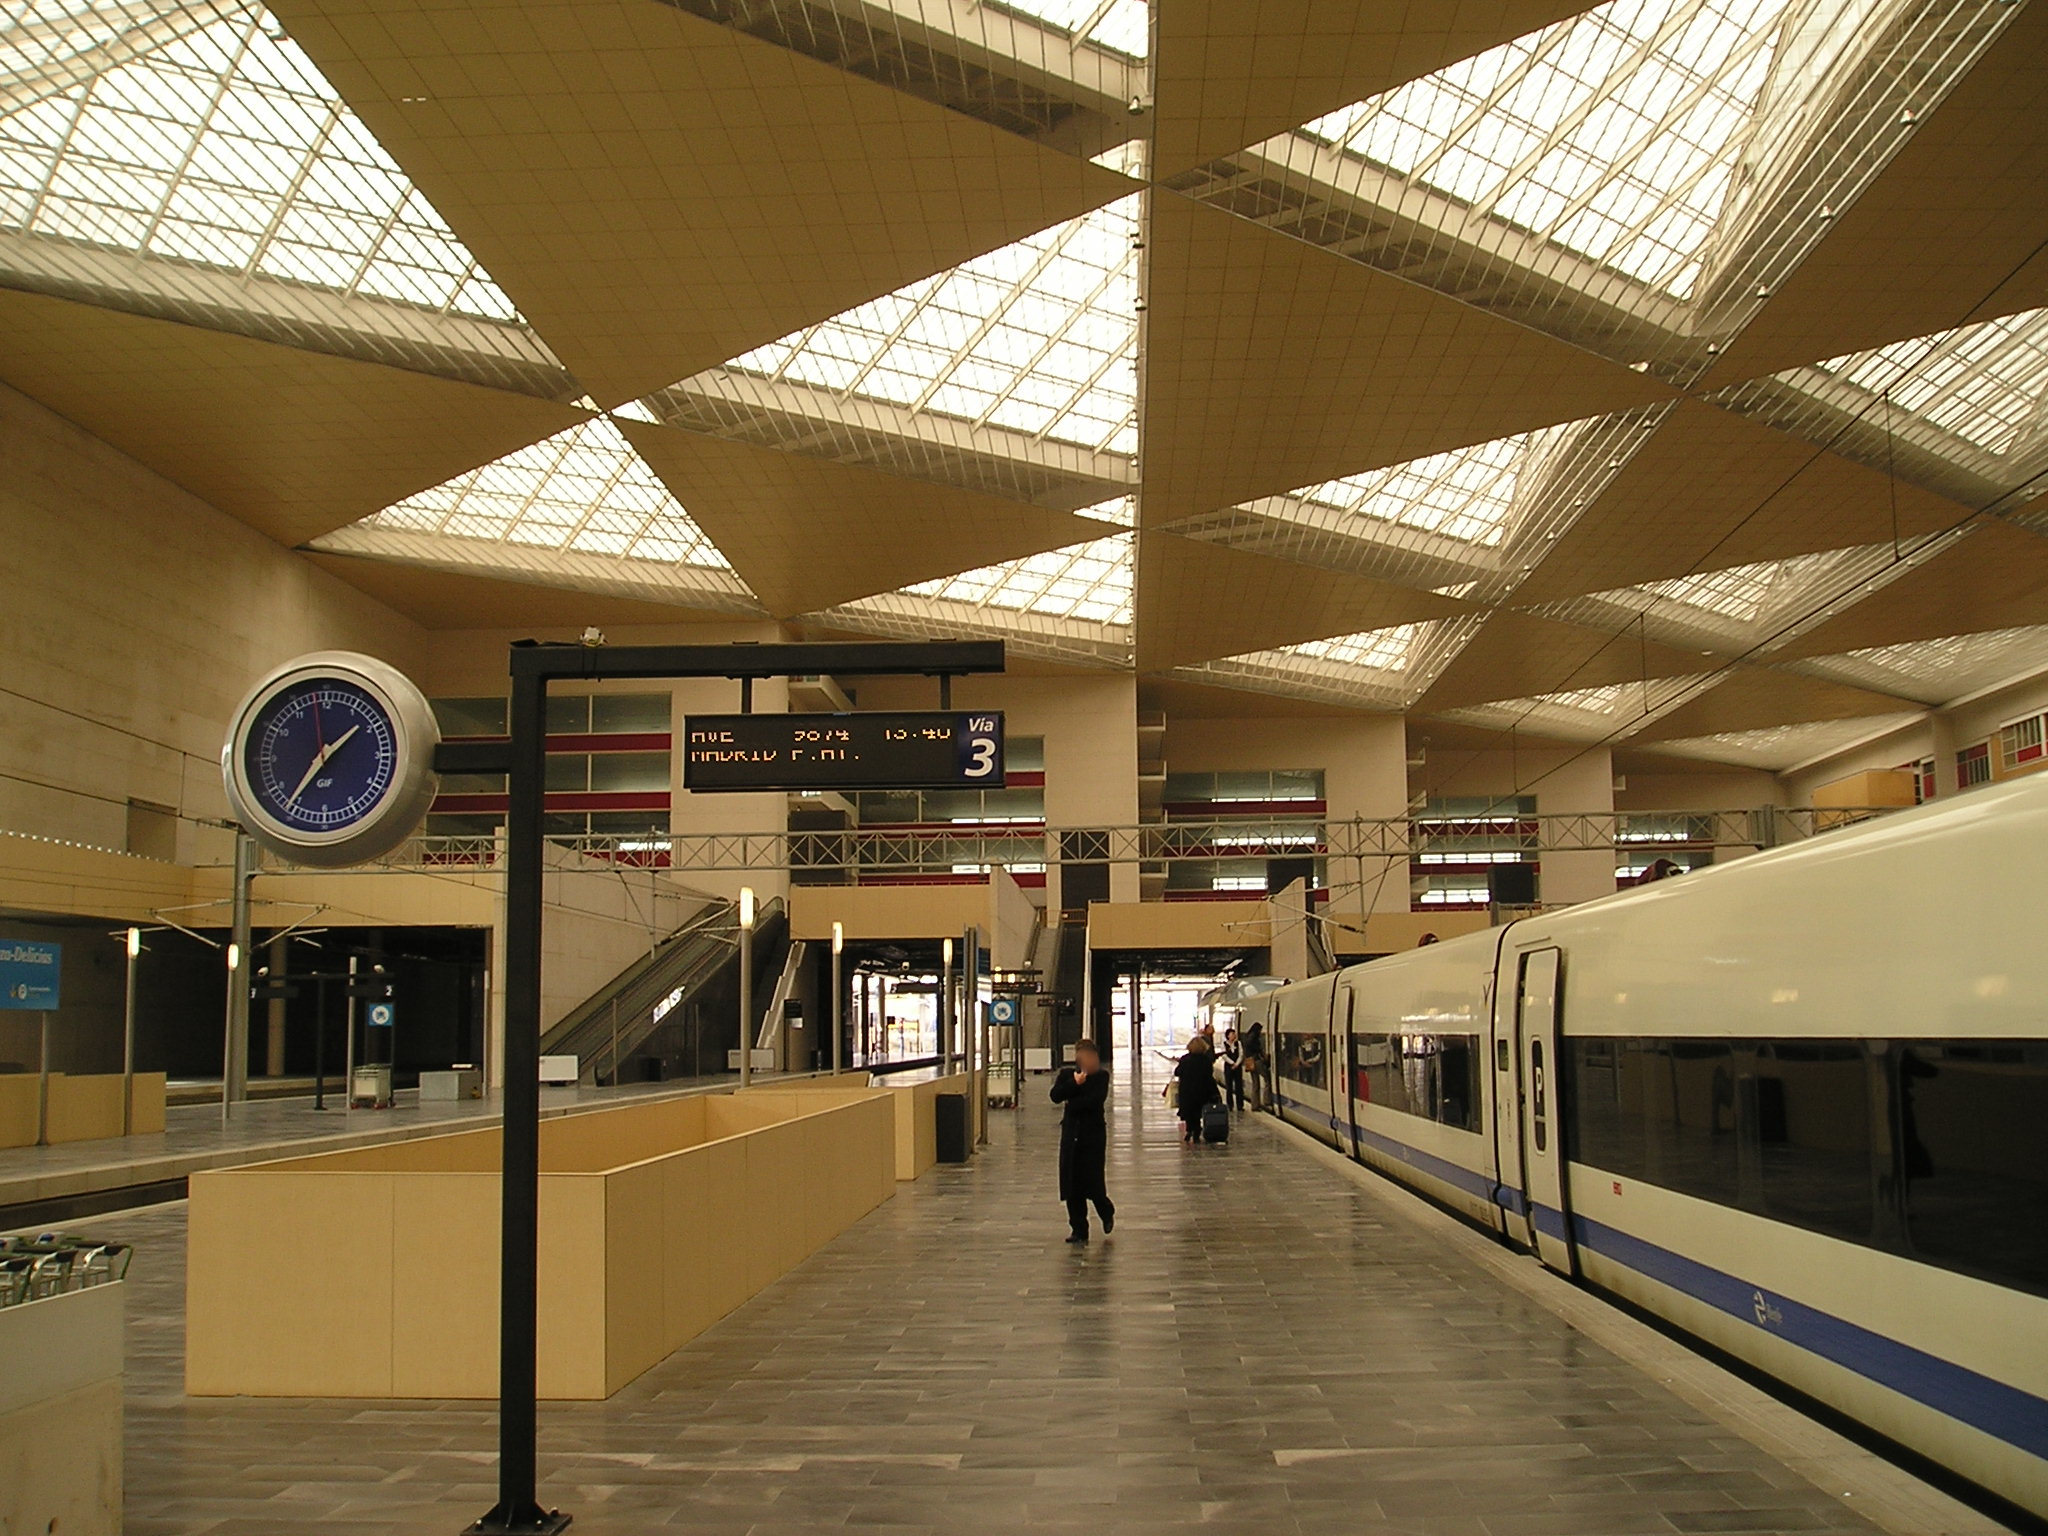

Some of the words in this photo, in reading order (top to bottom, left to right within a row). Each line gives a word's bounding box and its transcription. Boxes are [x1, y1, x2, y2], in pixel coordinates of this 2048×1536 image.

[295, 711, 304, 719] 11
[279, 728, 289, 737] 10
[366, 725, 373, 733] 2
[374, 751, 381, 759] 3
[964, 737, 997, 777] 3
[316, 778, 334, 789] GIF
[366, 777, 372, 785] 4
[347, 796, 354, 804] 5
[321, 804, 328, 812] 6
